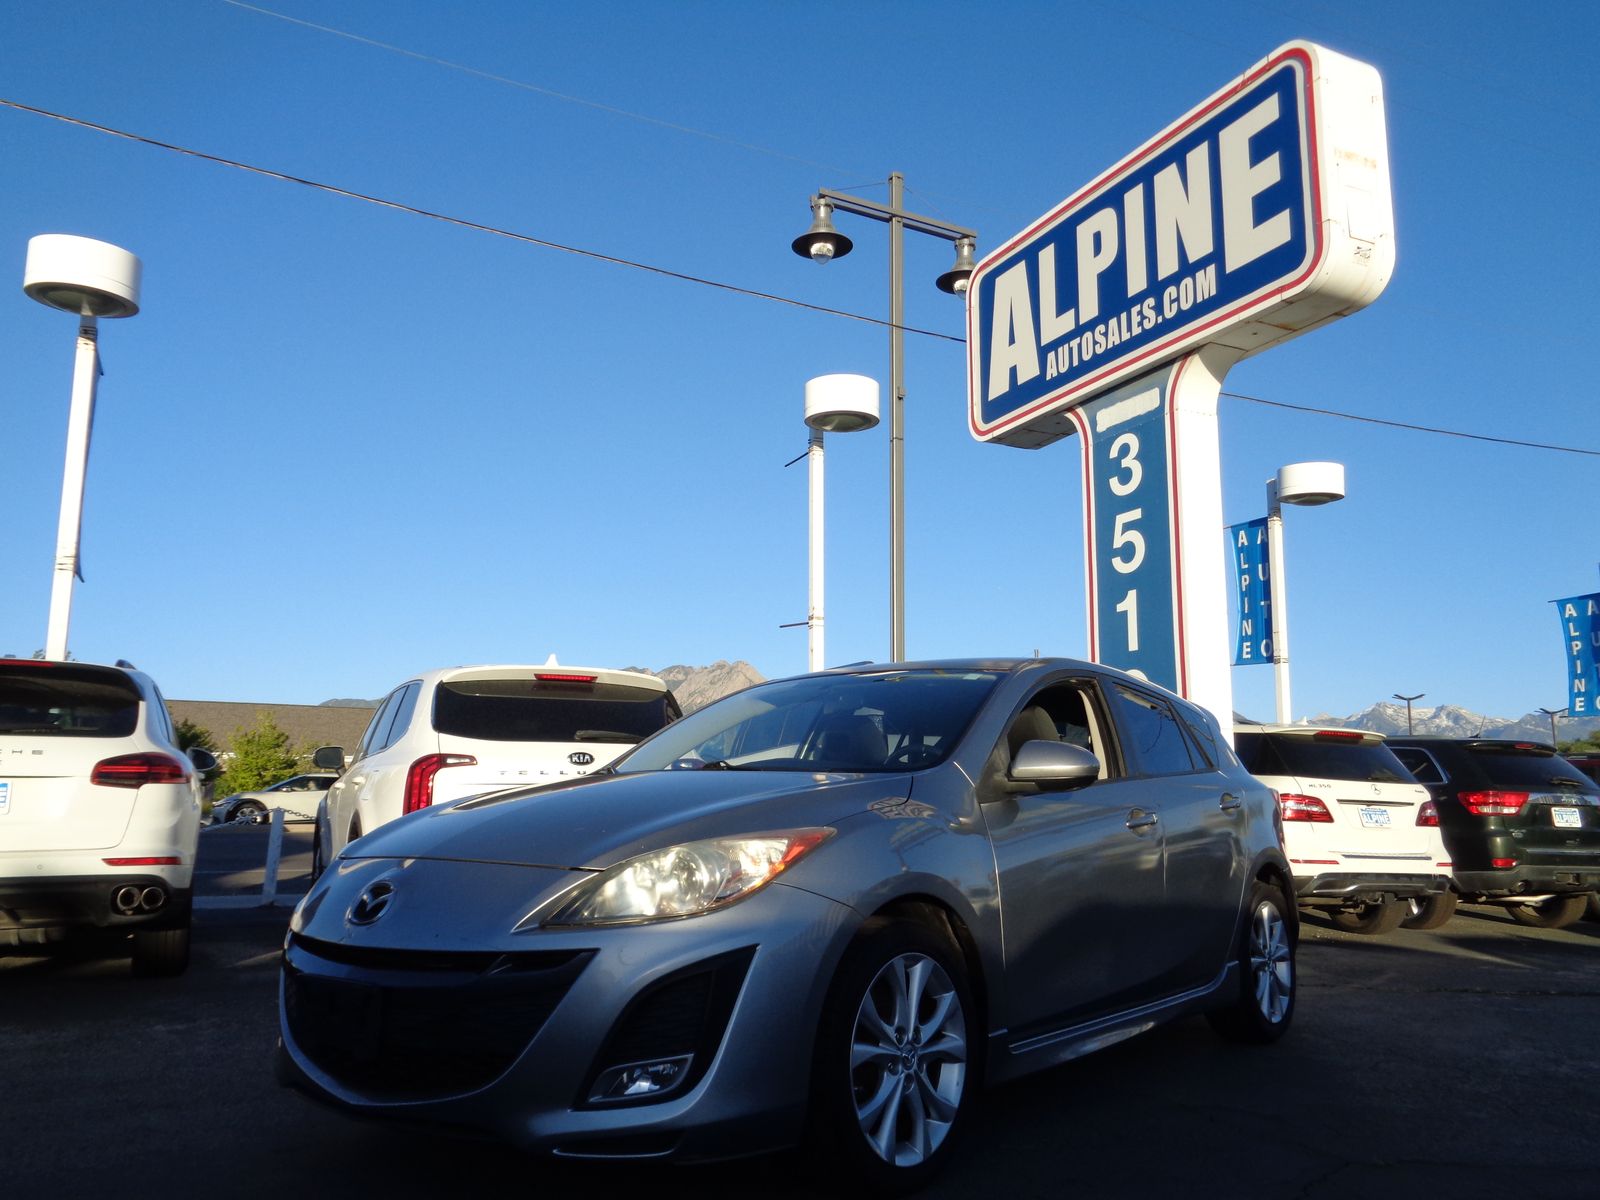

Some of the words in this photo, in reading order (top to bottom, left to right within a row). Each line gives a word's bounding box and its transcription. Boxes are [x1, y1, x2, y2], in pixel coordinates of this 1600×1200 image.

[988, 92, 1291, 401] ALPINE
[1046, 263, 1217, 380] AUTOSALES.COM
[1109, 432, 1149, 682] 351
[1238, 530, 1252, 658] ALPINE
[1565, 603, 1585, 711] ALPINE
[572, 753, 592, 763] KIA
